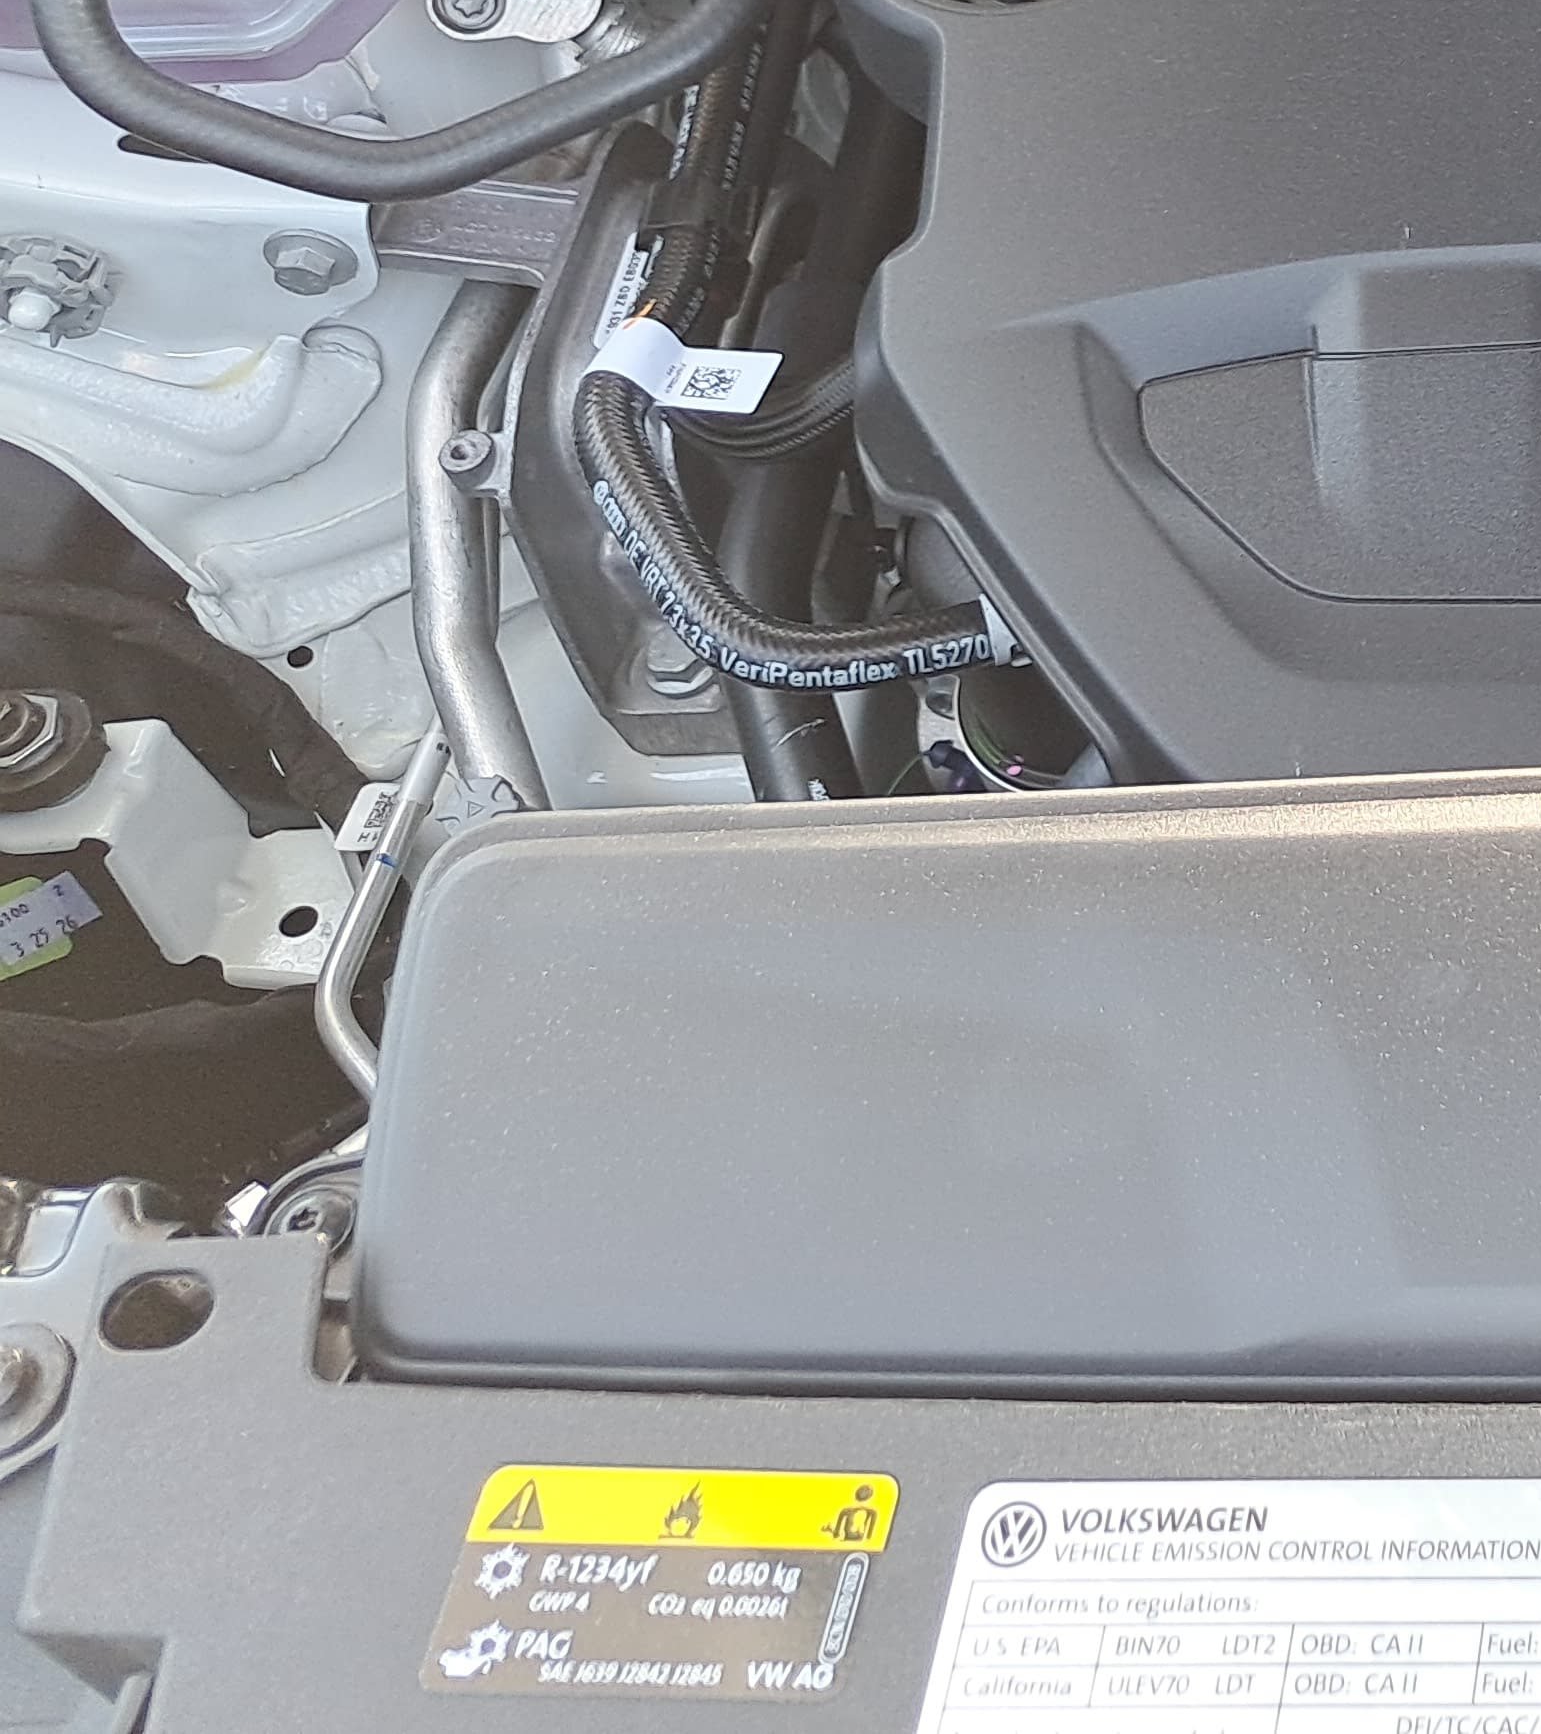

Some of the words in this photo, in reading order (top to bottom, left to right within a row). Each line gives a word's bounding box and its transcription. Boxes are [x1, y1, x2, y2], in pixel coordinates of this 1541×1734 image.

[720, 646, 897, 688] VeriPentaflex
[904, 633, 991, 675] TL5270
[1060, 1505, 1269, 1535] VOLKSWAGEN
[1053, 1541, 1144, 1565] VEHICLE
[1151, 1539, 1262, 1563] EMISSION
[1268, 1539, 1374, 1562] CONTROL
[1380, 1538, 1541, 1561] INFORMATION
[539, 1553, 660, 1592] R-1234yf
[706, 1560, 771, 1587] 0.650
[771, 1560, 802, 1594] kg
[981, 1592, 1091, 1616] Conforms
[1097, 1593, 1120, 1614] to
[1126, 1591, 1260, 1621] regulations:
[514, 1628, 576, 1660] PAG
[1114, 1634, 1182, 1656] BIN70
[1221, 1634, 1277, 1656] LDT2
[1300, 1633, 1357, 1656] OBD:
[1369, 1633, 1402, 1655] CA
[1486, 1632, 1539, 1655] Fuel:
[747, 1660, 794, 1690] VW
[791, 1661, 836, 1691] AG
[963, 1676, 1073, 1698] California
[1107, 1674, 1191, 1697] ULEV70
[1214, 1673, 1258, 1696] LDT
[1293, 1672, 1352, 1696] OBD:
[1363, 1672, 1397, 1695] CA
[1481, 1671, 1534, 1694] Fuel:
